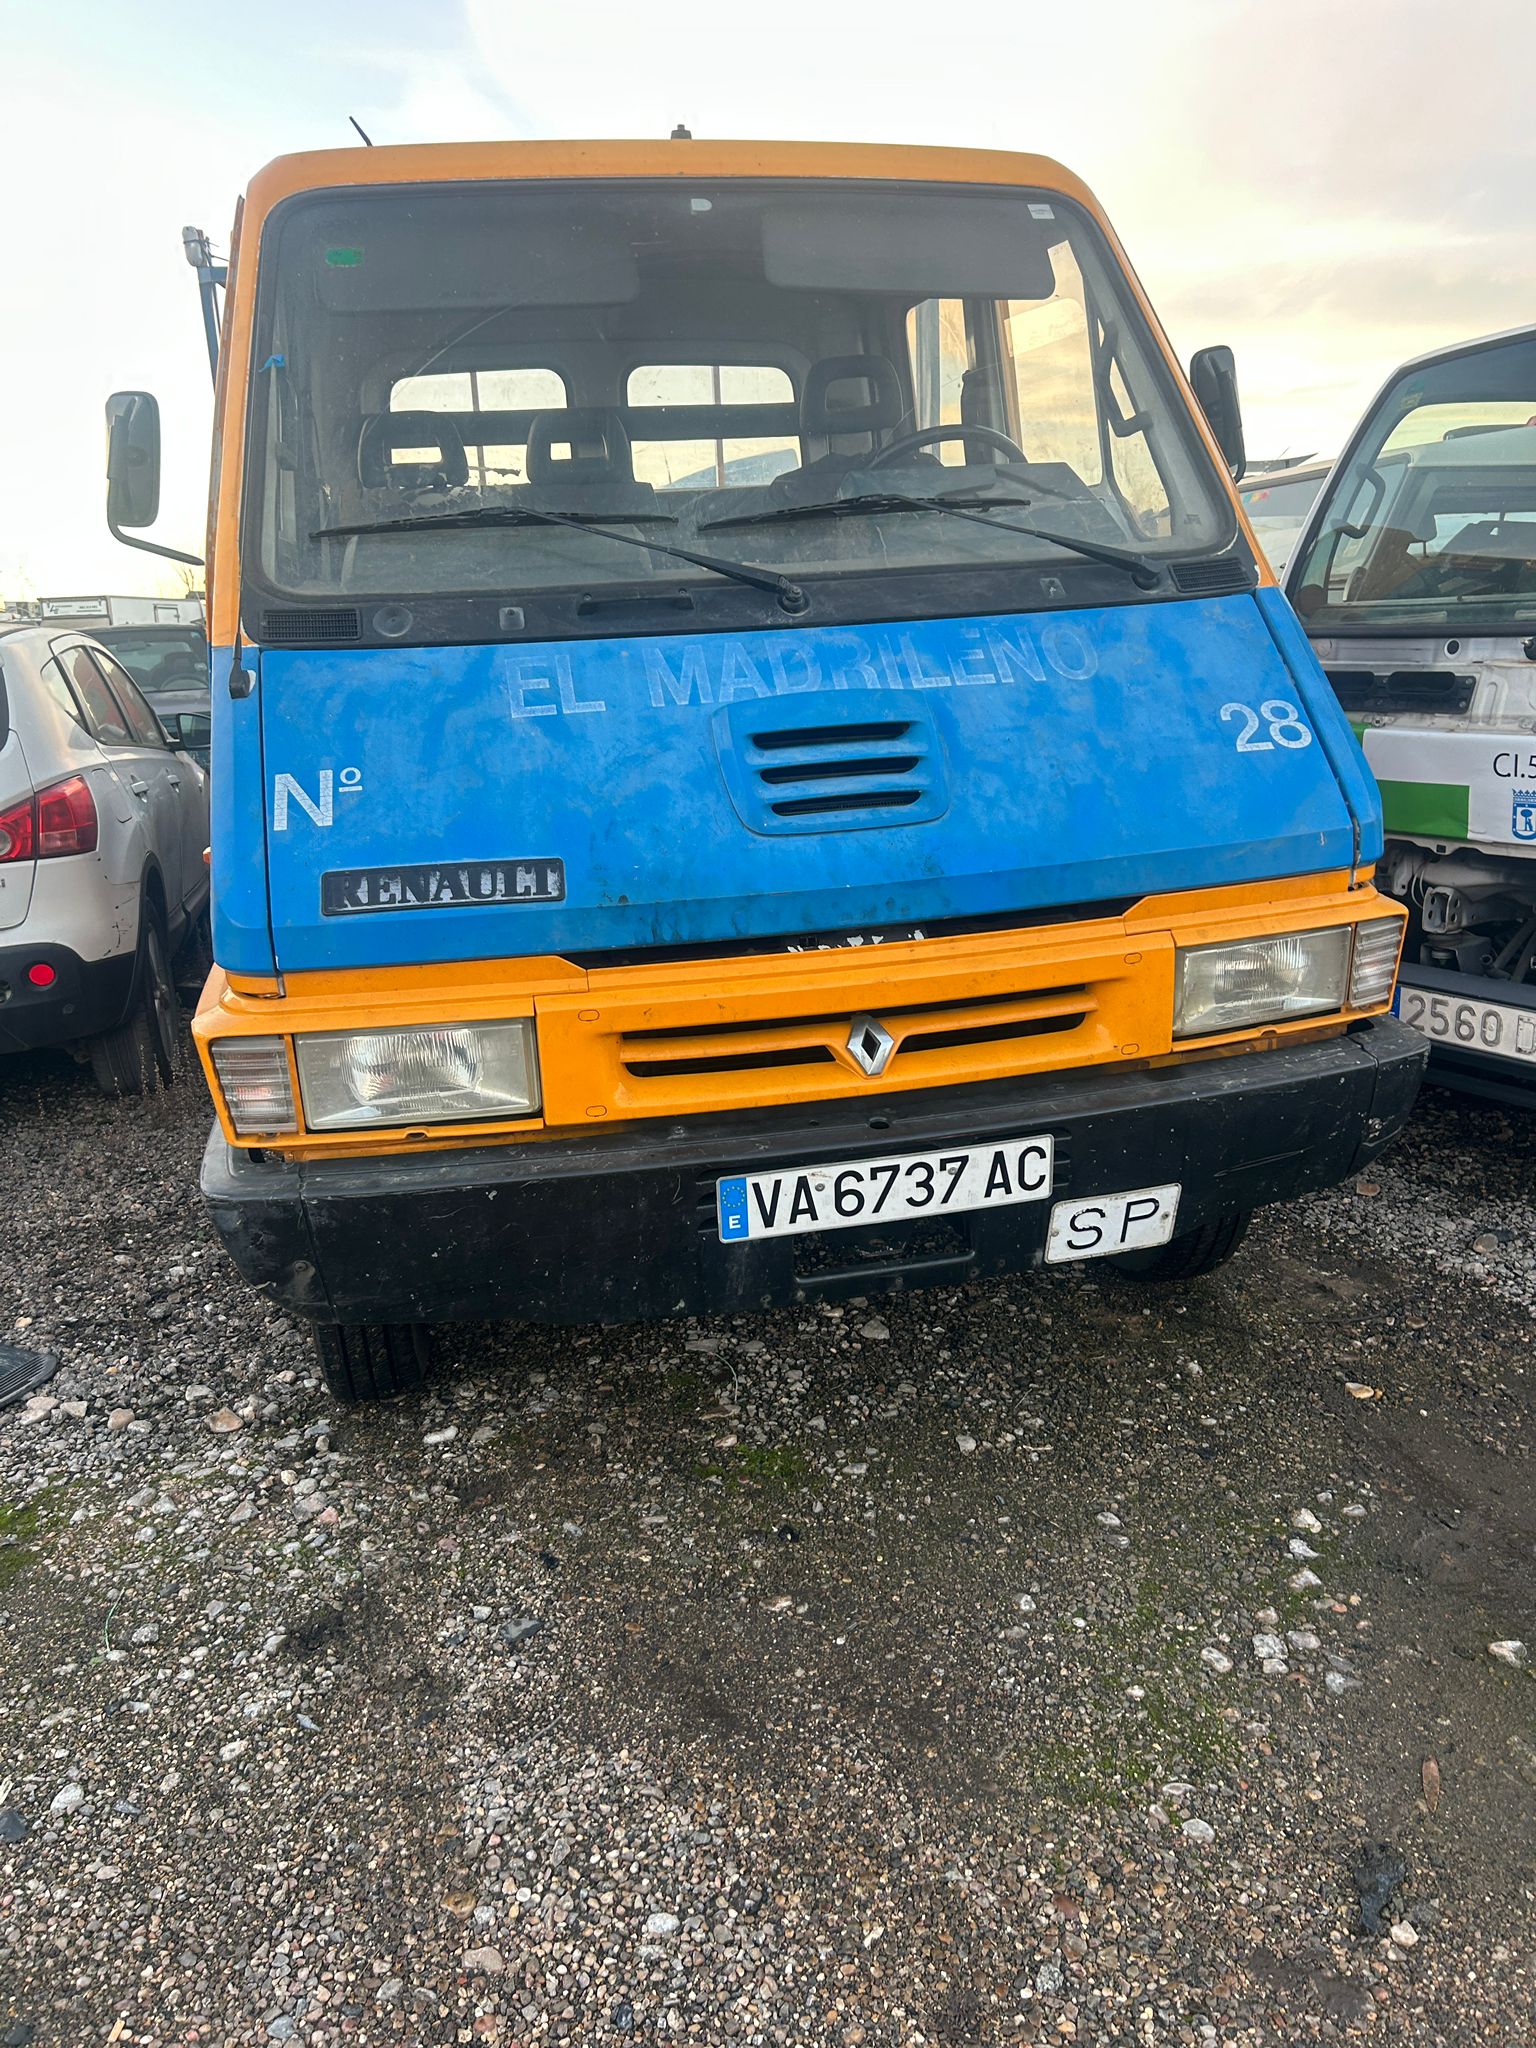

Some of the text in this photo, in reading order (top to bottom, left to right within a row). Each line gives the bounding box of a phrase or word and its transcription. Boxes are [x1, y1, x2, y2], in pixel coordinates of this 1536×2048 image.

[505, 654, 607, 719] EL
[1220, 699, 1312, 753] 28
[333, 862, 558, 908] RENAULT
[1406, 993, 1503, 1047] 2560
[752, 1145, 1047, 1229] VA 6737 AC
[728, 1214, 741, 1230] E
